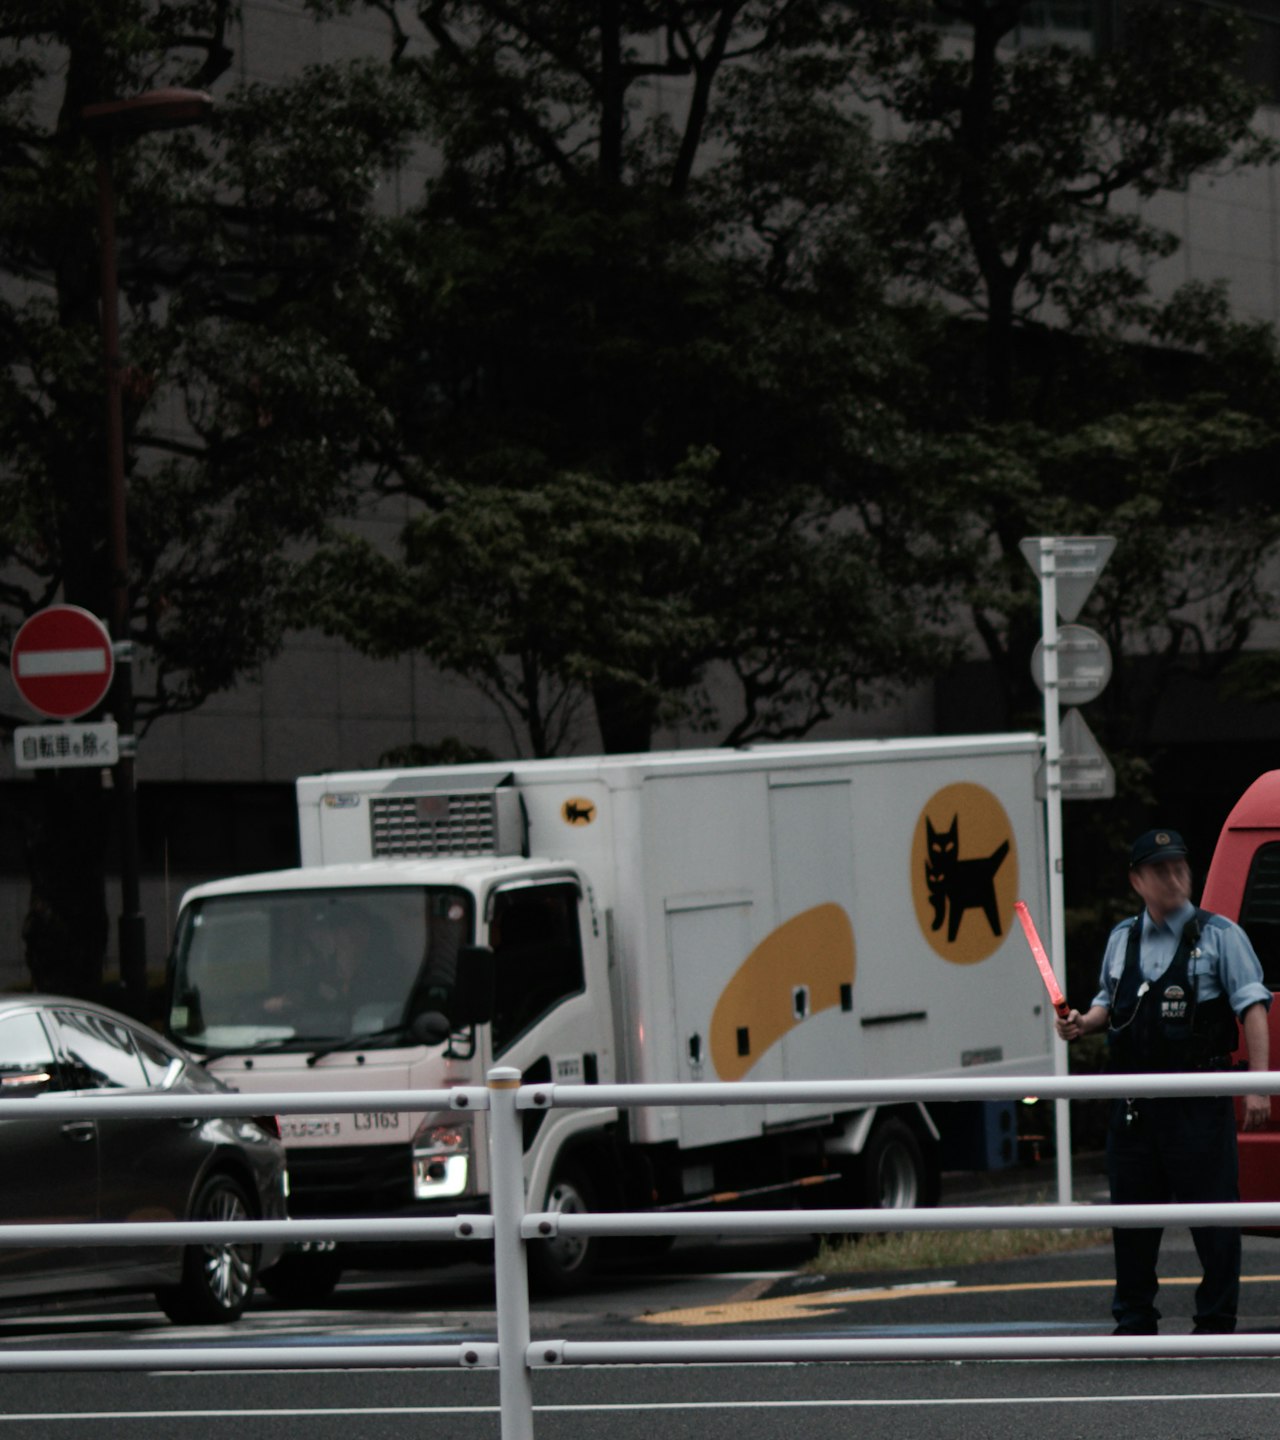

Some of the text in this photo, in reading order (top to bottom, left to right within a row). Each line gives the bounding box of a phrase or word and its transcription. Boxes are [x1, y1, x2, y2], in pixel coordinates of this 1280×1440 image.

[22, 732, 110, 761] 自転車を除く
